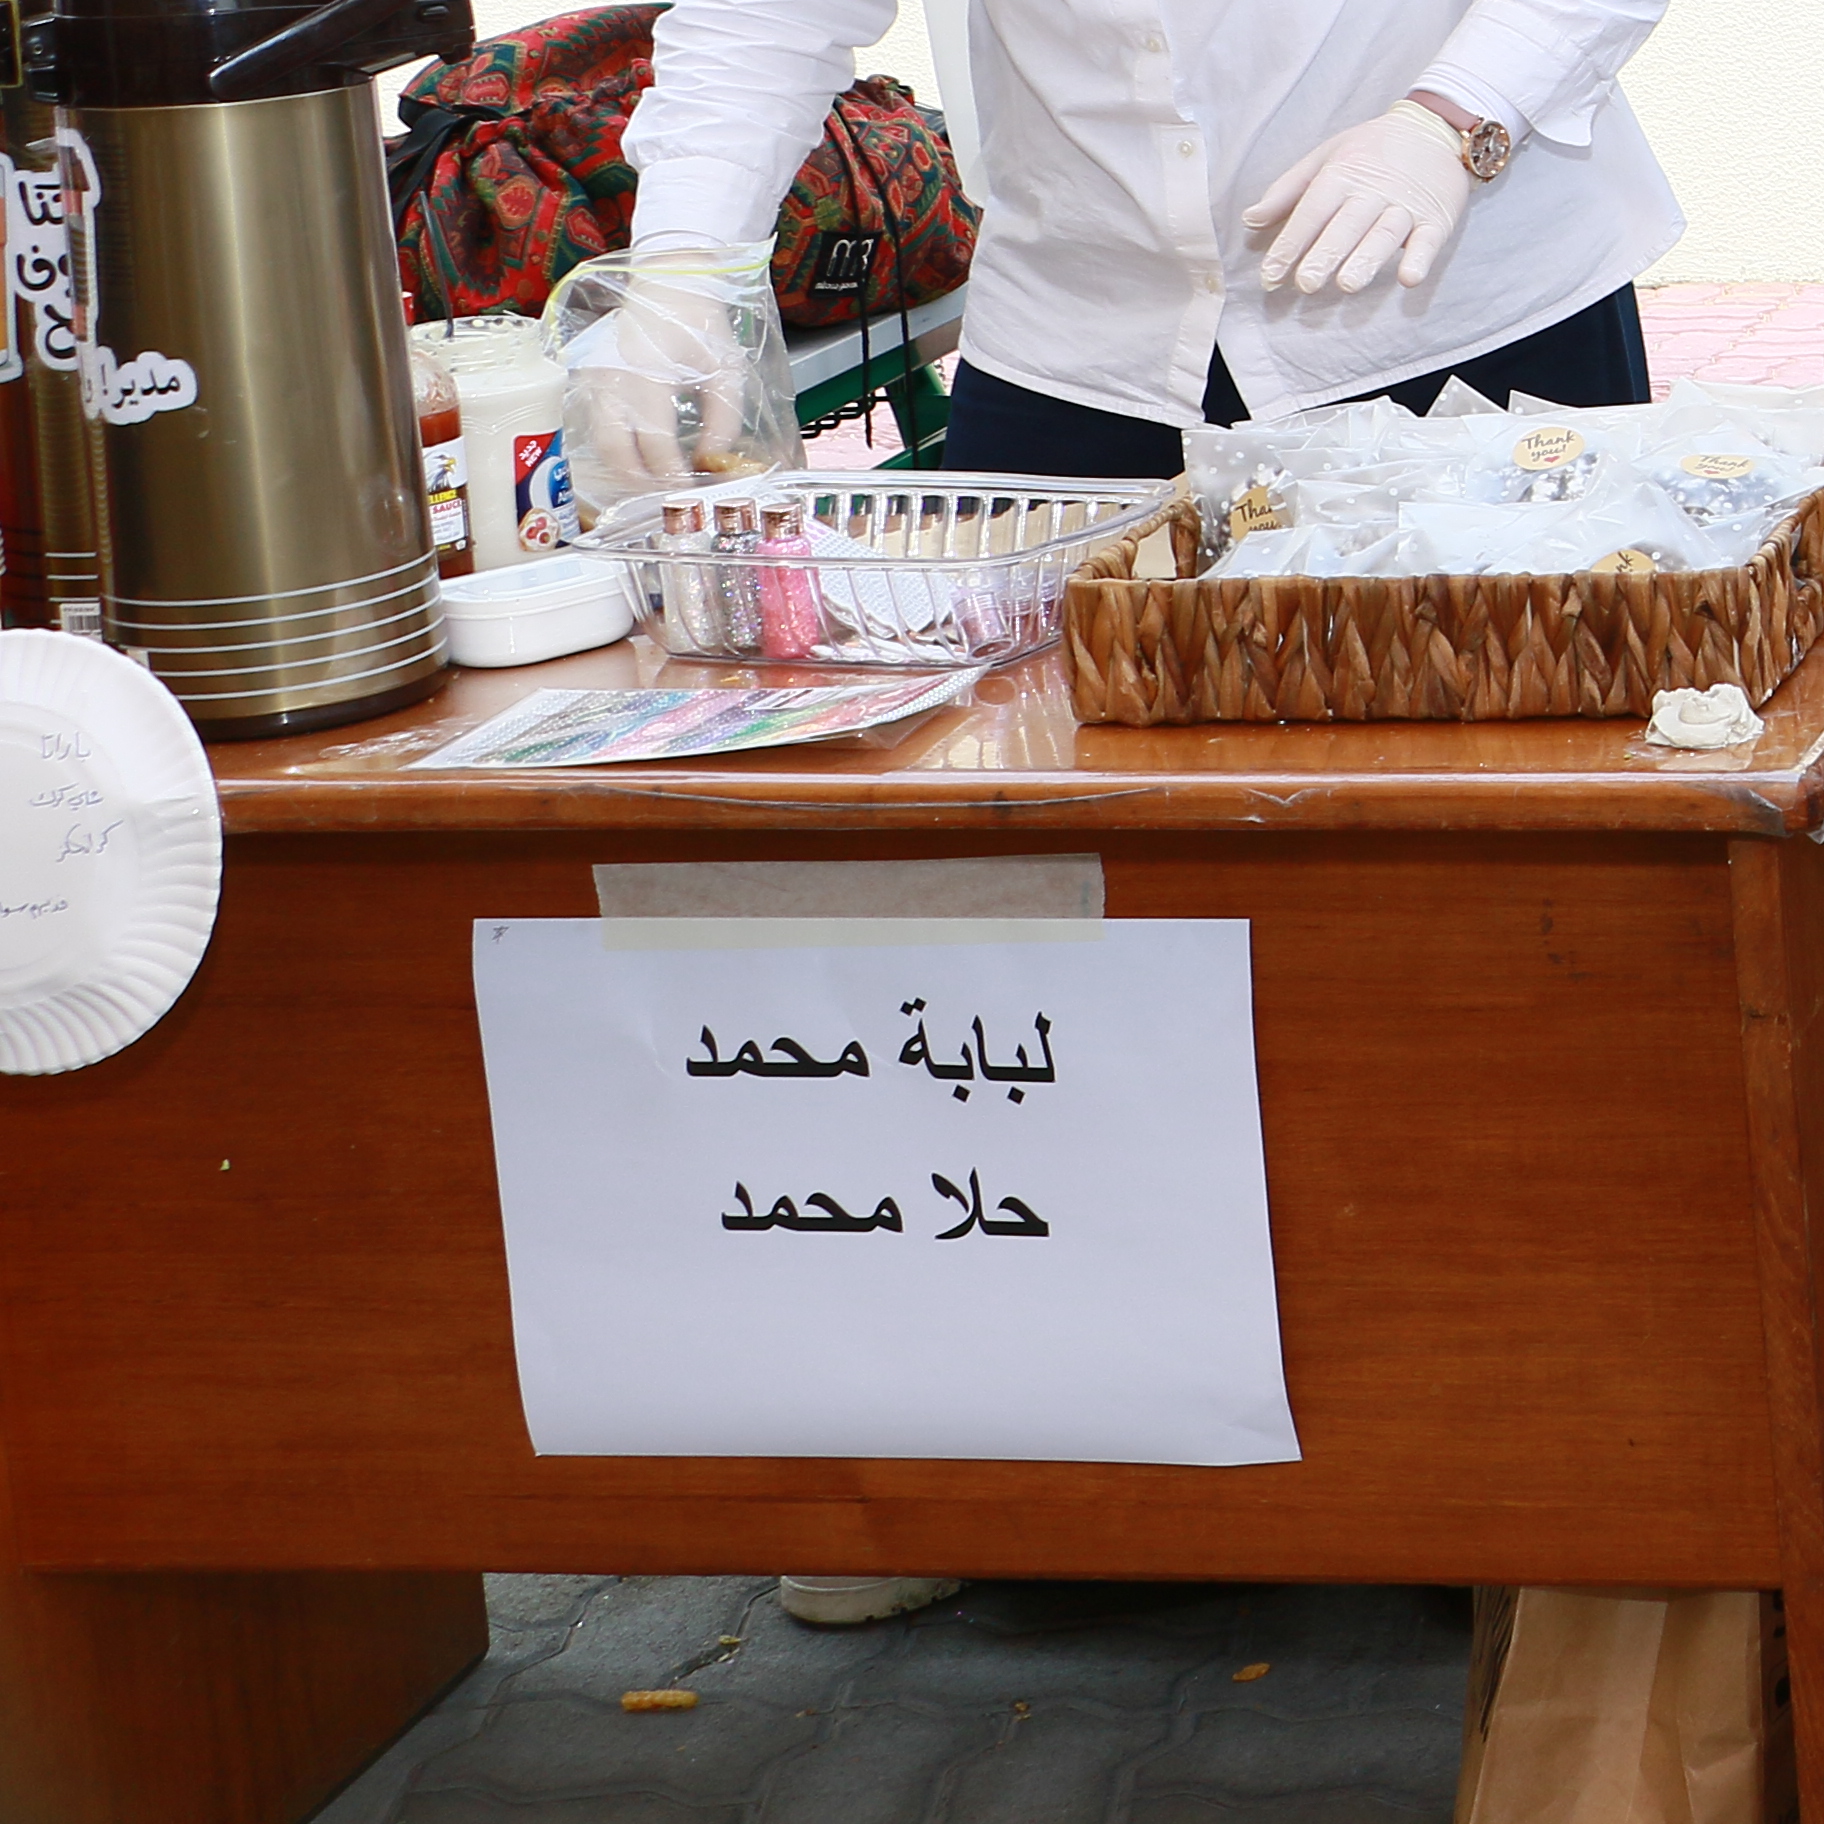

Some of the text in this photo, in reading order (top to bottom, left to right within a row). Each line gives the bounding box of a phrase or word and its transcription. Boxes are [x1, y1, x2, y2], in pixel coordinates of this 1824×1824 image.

[1522, 429, 1575, 450] Thank
[525, 447, 543, 468] NEW
[1531, 444, 1567, 462] you!
[1700, 454, 1751, 470] Thank
[432, 498, 461, 514] SAUCE
[686, 997, 1056, 1105] لبابة محمد
[721, 1167, 1050, 1240] حلا محمد
